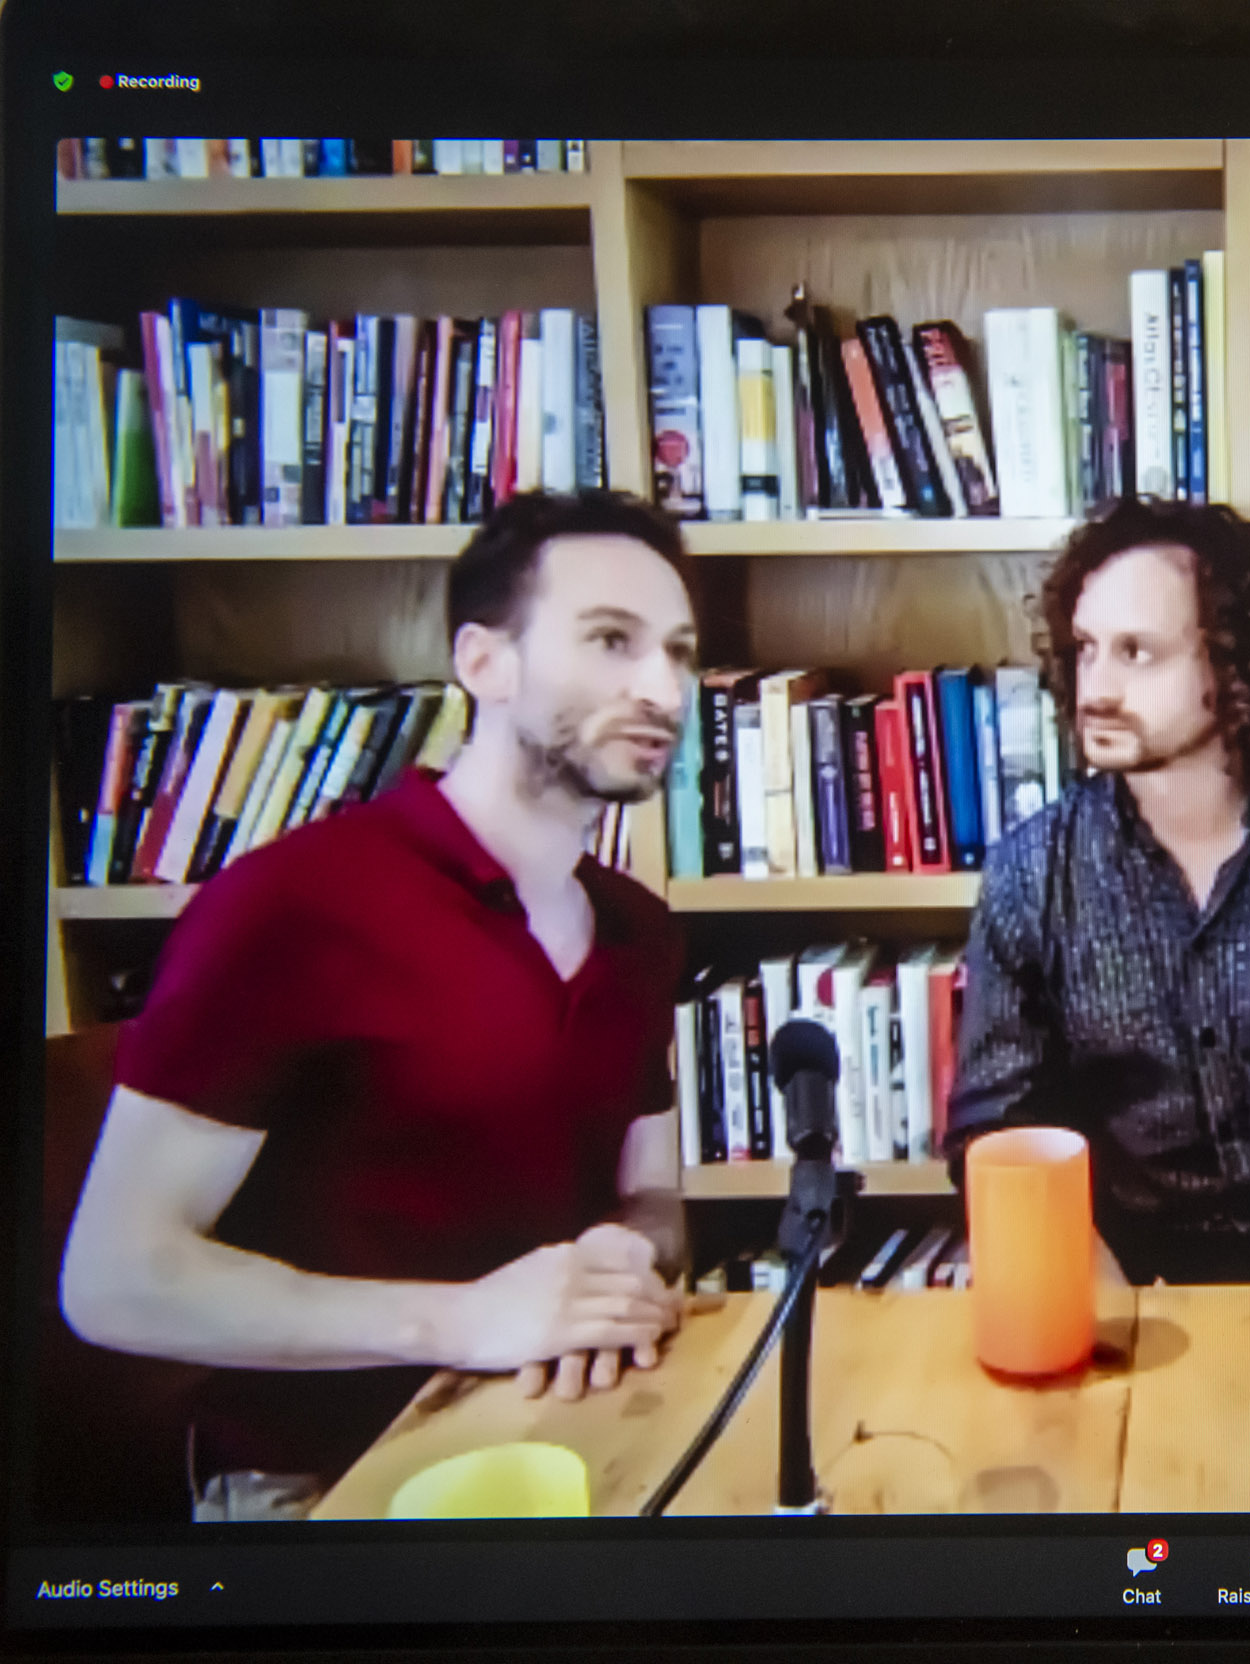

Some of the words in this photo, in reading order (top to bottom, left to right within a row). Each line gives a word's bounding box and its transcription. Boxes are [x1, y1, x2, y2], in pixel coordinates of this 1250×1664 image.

[117, 73, 201, 91] Recording
[1152, 1543, 1163, 1559] 2
[36, 1579, 94, 1600] Audio
[96, 1578, 179, 1601] Settings
[1122, 1587, 1162, 1605] Chat
